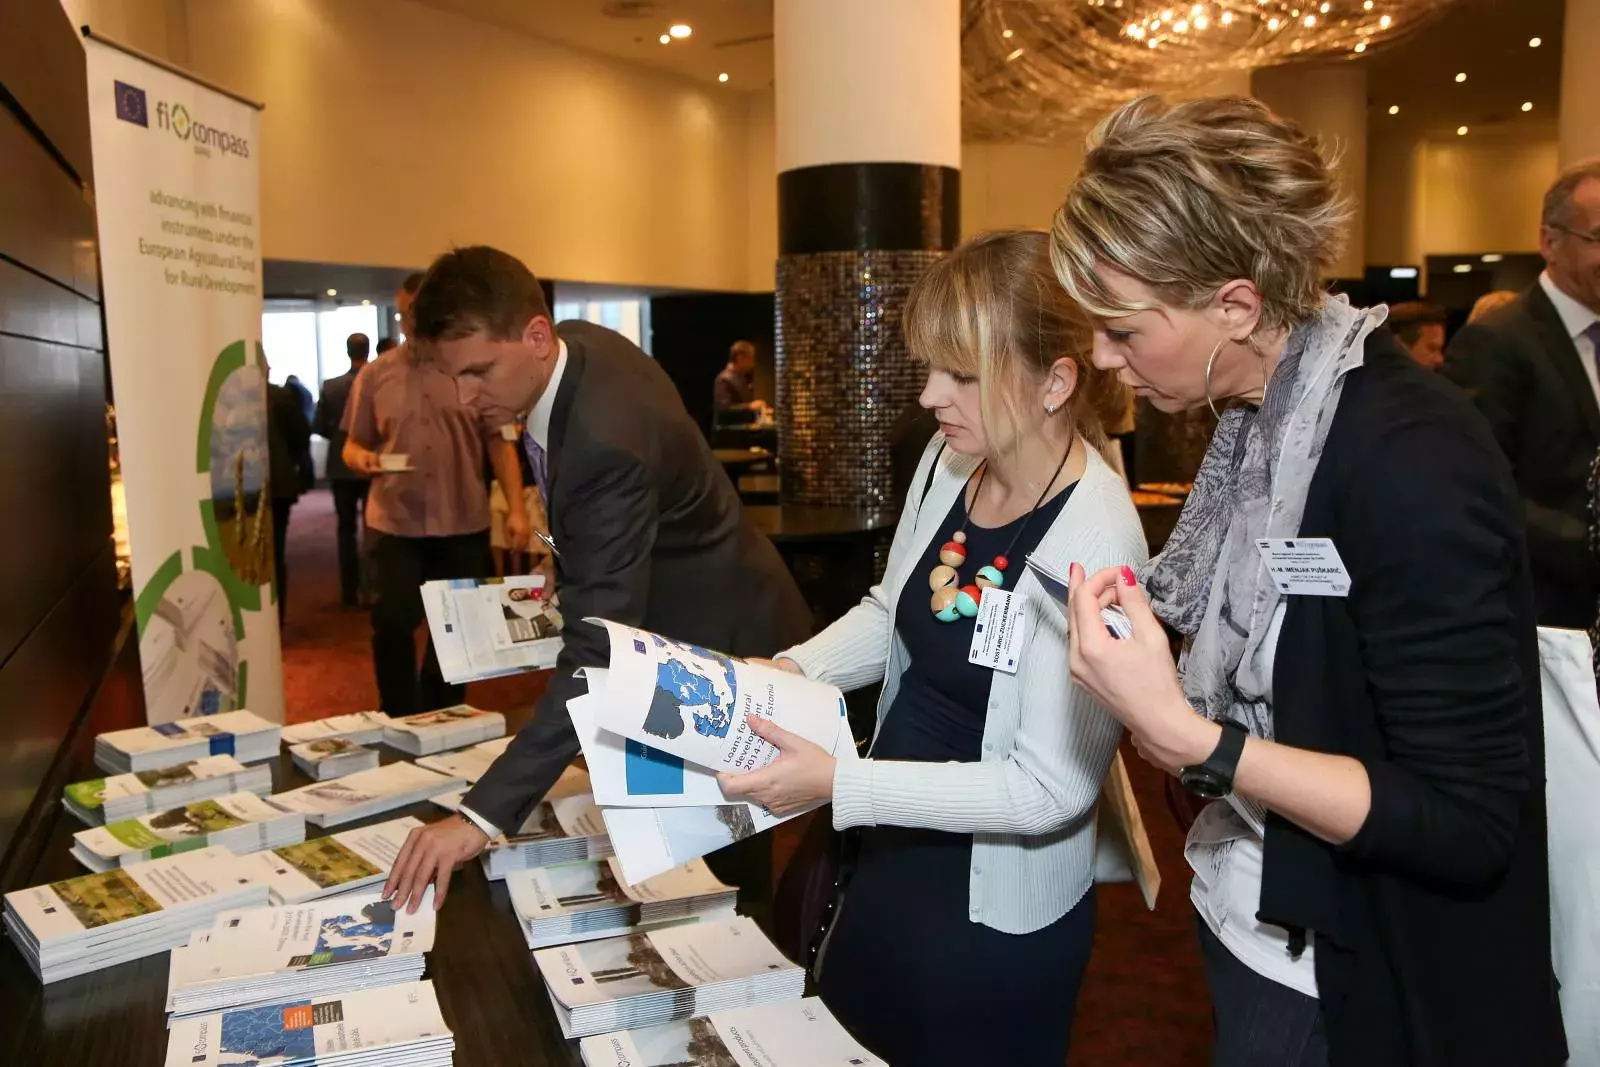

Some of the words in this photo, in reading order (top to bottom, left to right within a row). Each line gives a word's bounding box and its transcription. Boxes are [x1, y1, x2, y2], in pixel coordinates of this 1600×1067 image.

[161, 217, 214, 243] instruments
[215, 230, 241, 247] under
[241, 233, 254, 250] the
[139, 236, 187, 261] European
[188, 247, 236, 269] Agricultural
[236, 255, 255, 274] Fund
[164, 267, 180, 286] for
[181, 271, 204, 289] Rural
[204, 274, 258, 296] Development
[765, 683, 775, 717] Estonia
[723, 735, 742, 764] Loans
[737, 719, 749, 734] for
[743, 693, 753, 717] rural
